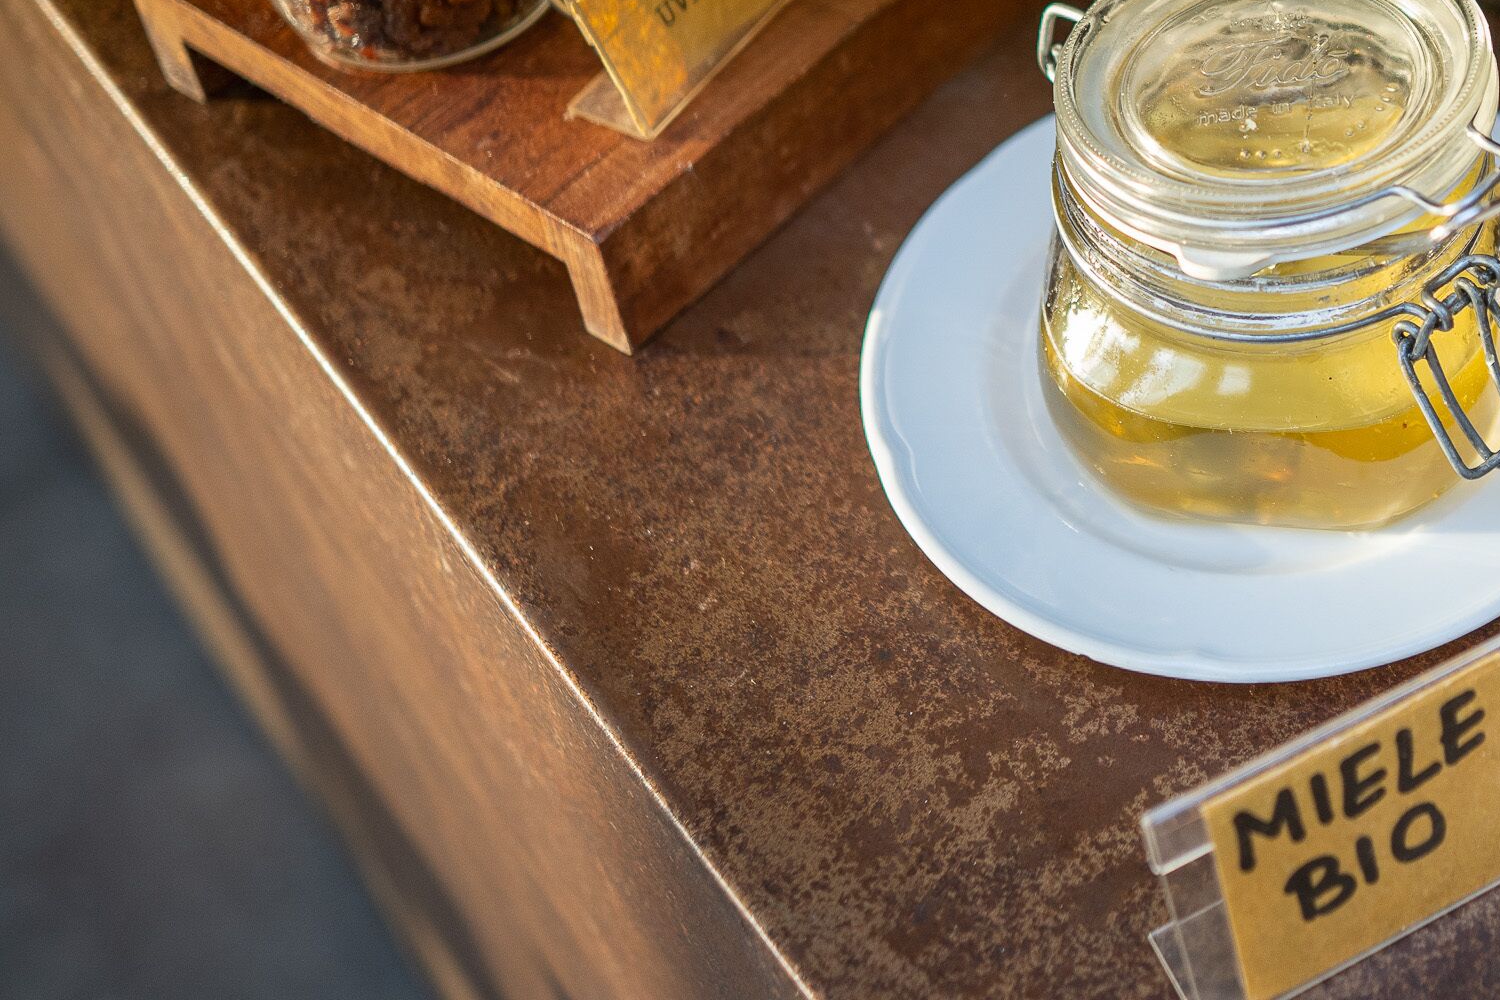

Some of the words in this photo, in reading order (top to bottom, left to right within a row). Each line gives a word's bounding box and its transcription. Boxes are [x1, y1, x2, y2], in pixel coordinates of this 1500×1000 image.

[1197, 105, 1258, 126] made
[1271, 102, 1292, 115] in
[1233, 689, 1487, 874] MIELE
[1284, 801, 1447, 923] BIO
